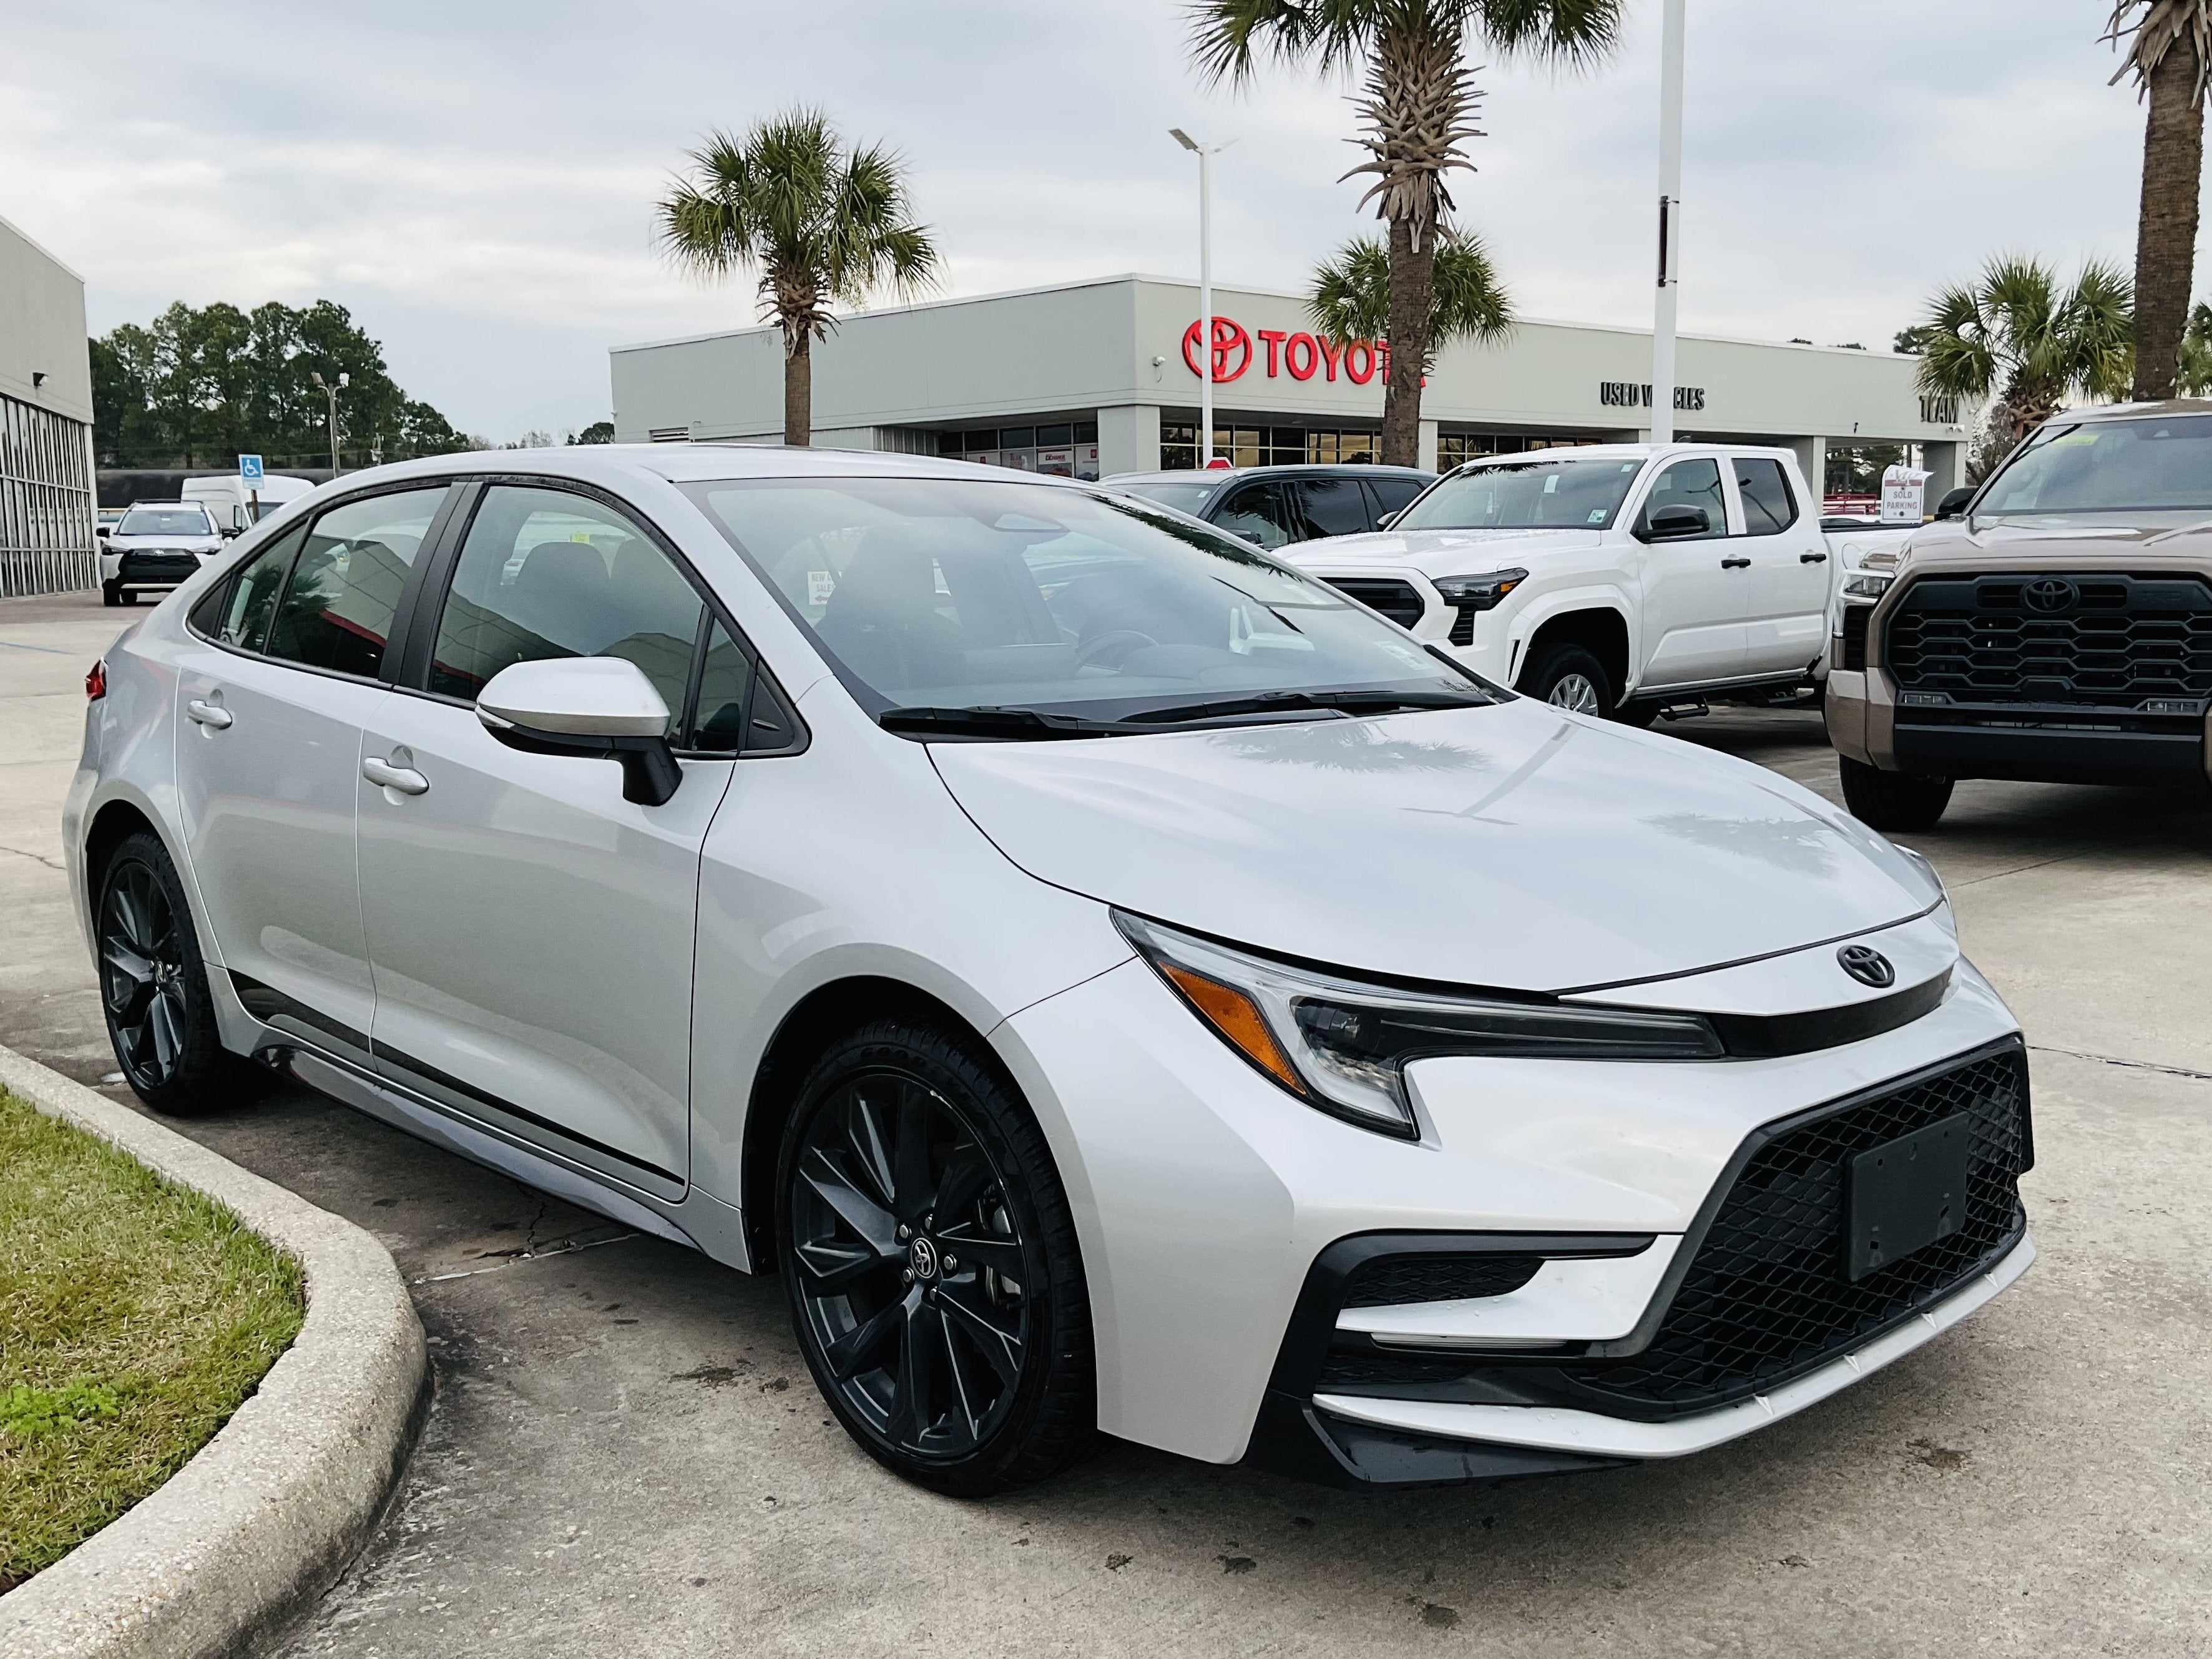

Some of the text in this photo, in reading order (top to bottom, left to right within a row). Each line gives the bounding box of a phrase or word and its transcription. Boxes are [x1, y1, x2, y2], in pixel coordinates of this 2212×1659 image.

[1258, 330, 1426, 388] TOYOT
[1601, 382, 1705, 410] USED VCLES
[1887, 501, 1917, 509] PARKING
